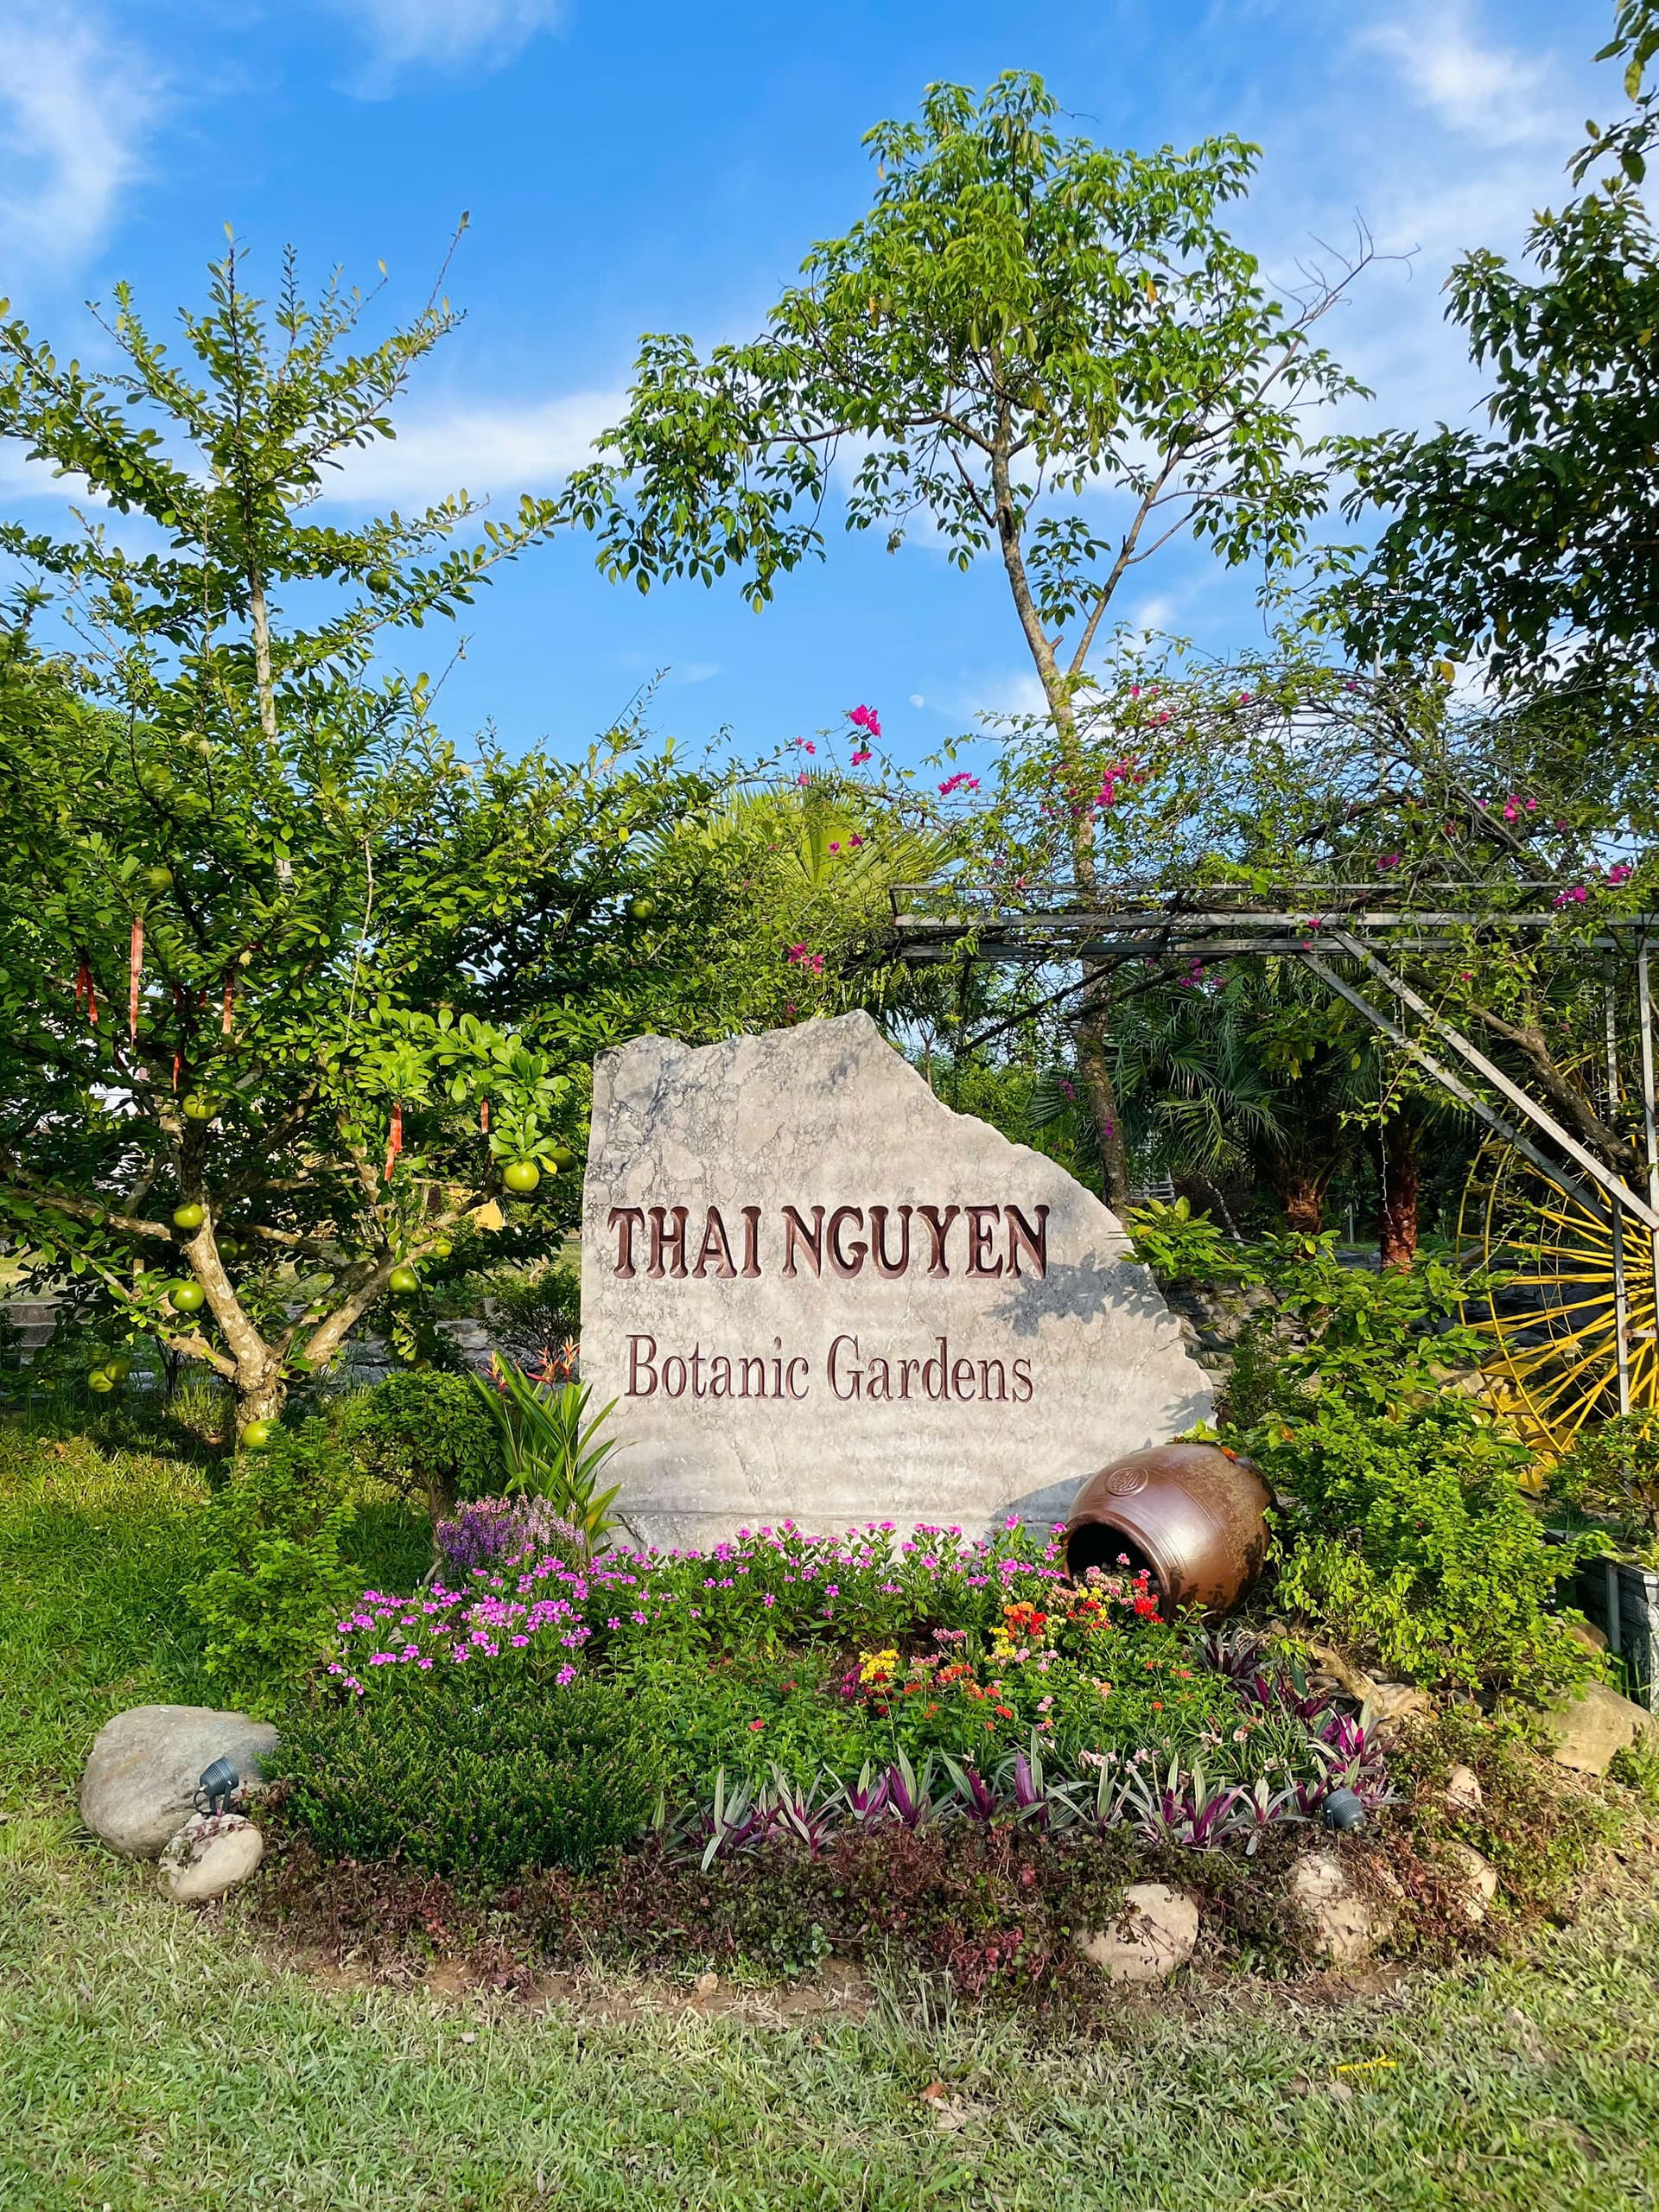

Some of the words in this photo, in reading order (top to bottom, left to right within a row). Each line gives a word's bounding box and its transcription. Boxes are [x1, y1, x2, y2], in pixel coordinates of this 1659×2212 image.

[607, 1205, 762, 1279] THAI
[781, 1205, 1051, 1280] NGUYEN
[624, 1334, 810, 1399] Botanic
[828, 1334, 1033, 1403] Gardens
